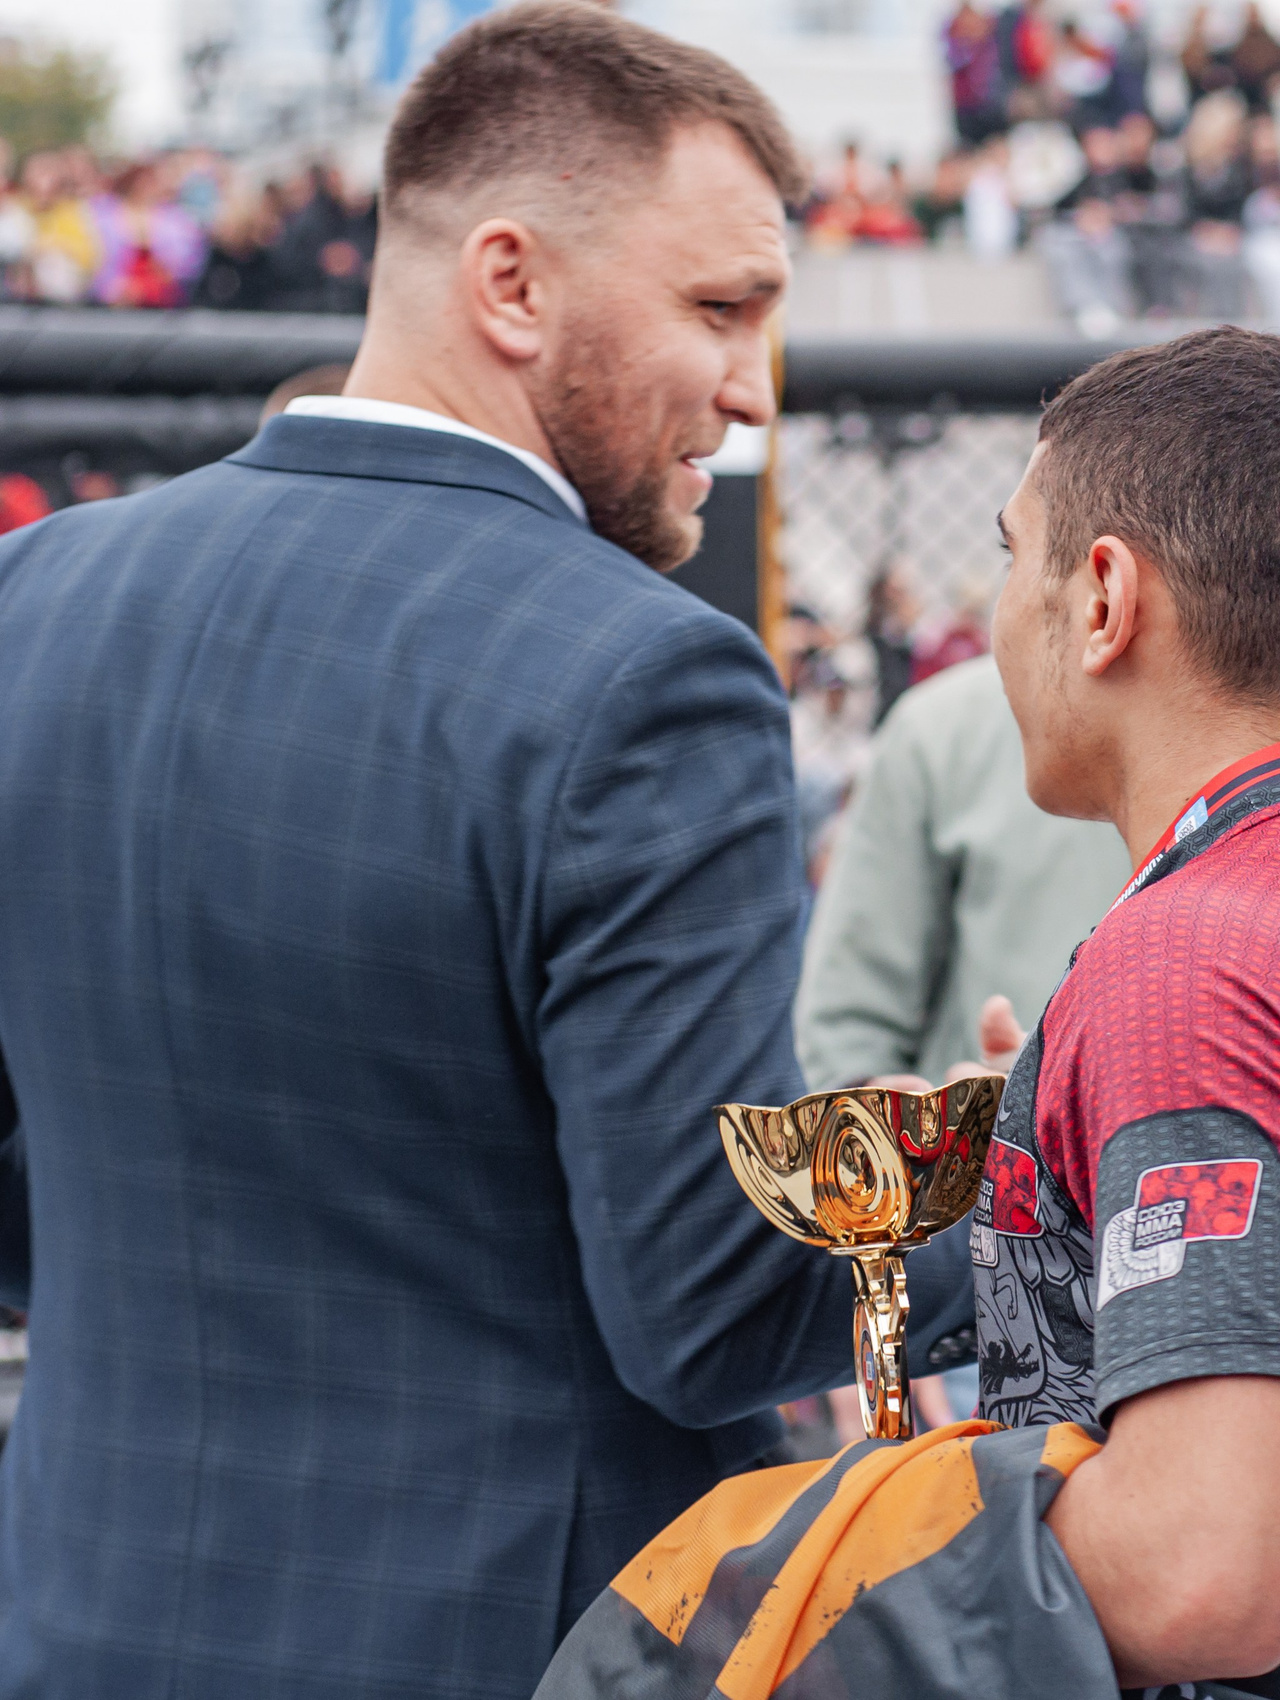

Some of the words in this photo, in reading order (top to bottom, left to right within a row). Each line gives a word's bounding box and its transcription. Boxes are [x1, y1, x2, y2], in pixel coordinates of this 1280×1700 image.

[1137, 1200, 1186, 1222] СОЮЗ
[1135, 1213, 1183, 1238] ММА
[1134, 1228, 1183, 1248] РОССИИ
